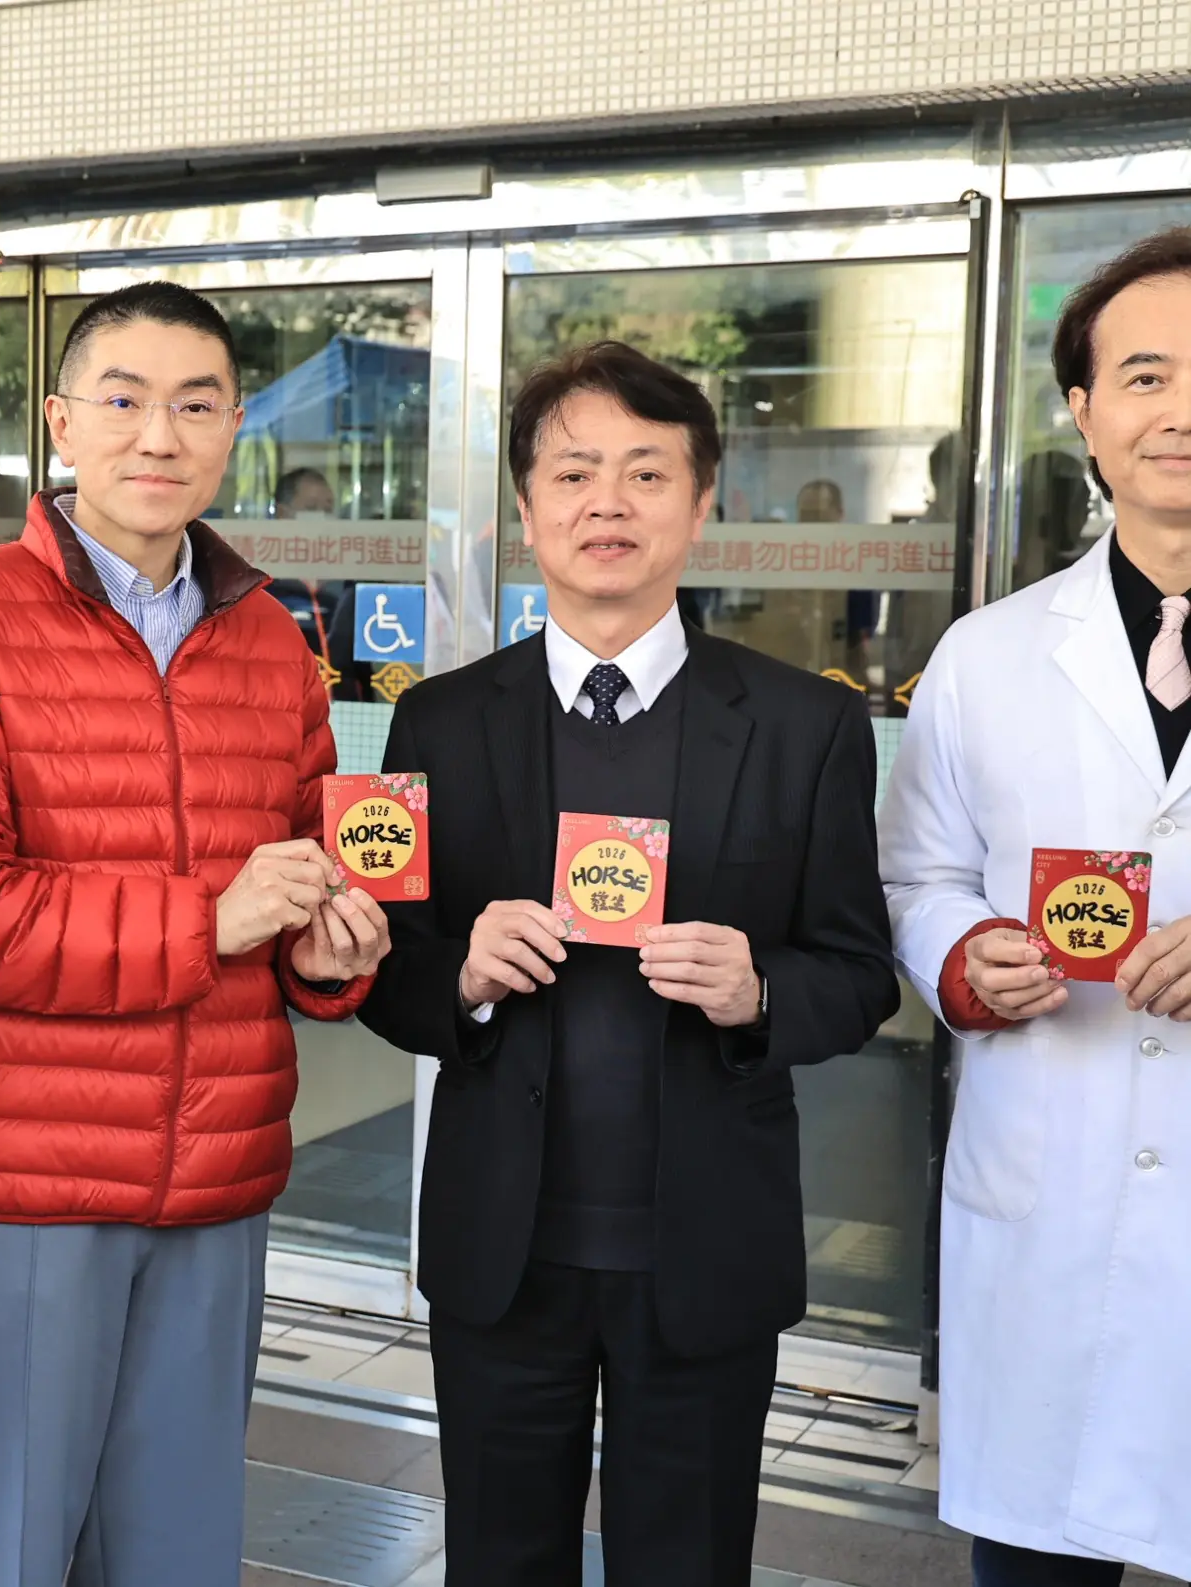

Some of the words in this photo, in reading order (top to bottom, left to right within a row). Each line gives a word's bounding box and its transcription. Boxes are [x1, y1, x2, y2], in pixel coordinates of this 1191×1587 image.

[363, 805, 390, 818] 2026
[340, 823, 412, 848] HORSE
[598, 847, 626, 860] 2026
[571, 865, 649, 893] HORSE
[1074, 883, 1106, 896] 2026
[1046, 902, 1130, 928] HORSE
